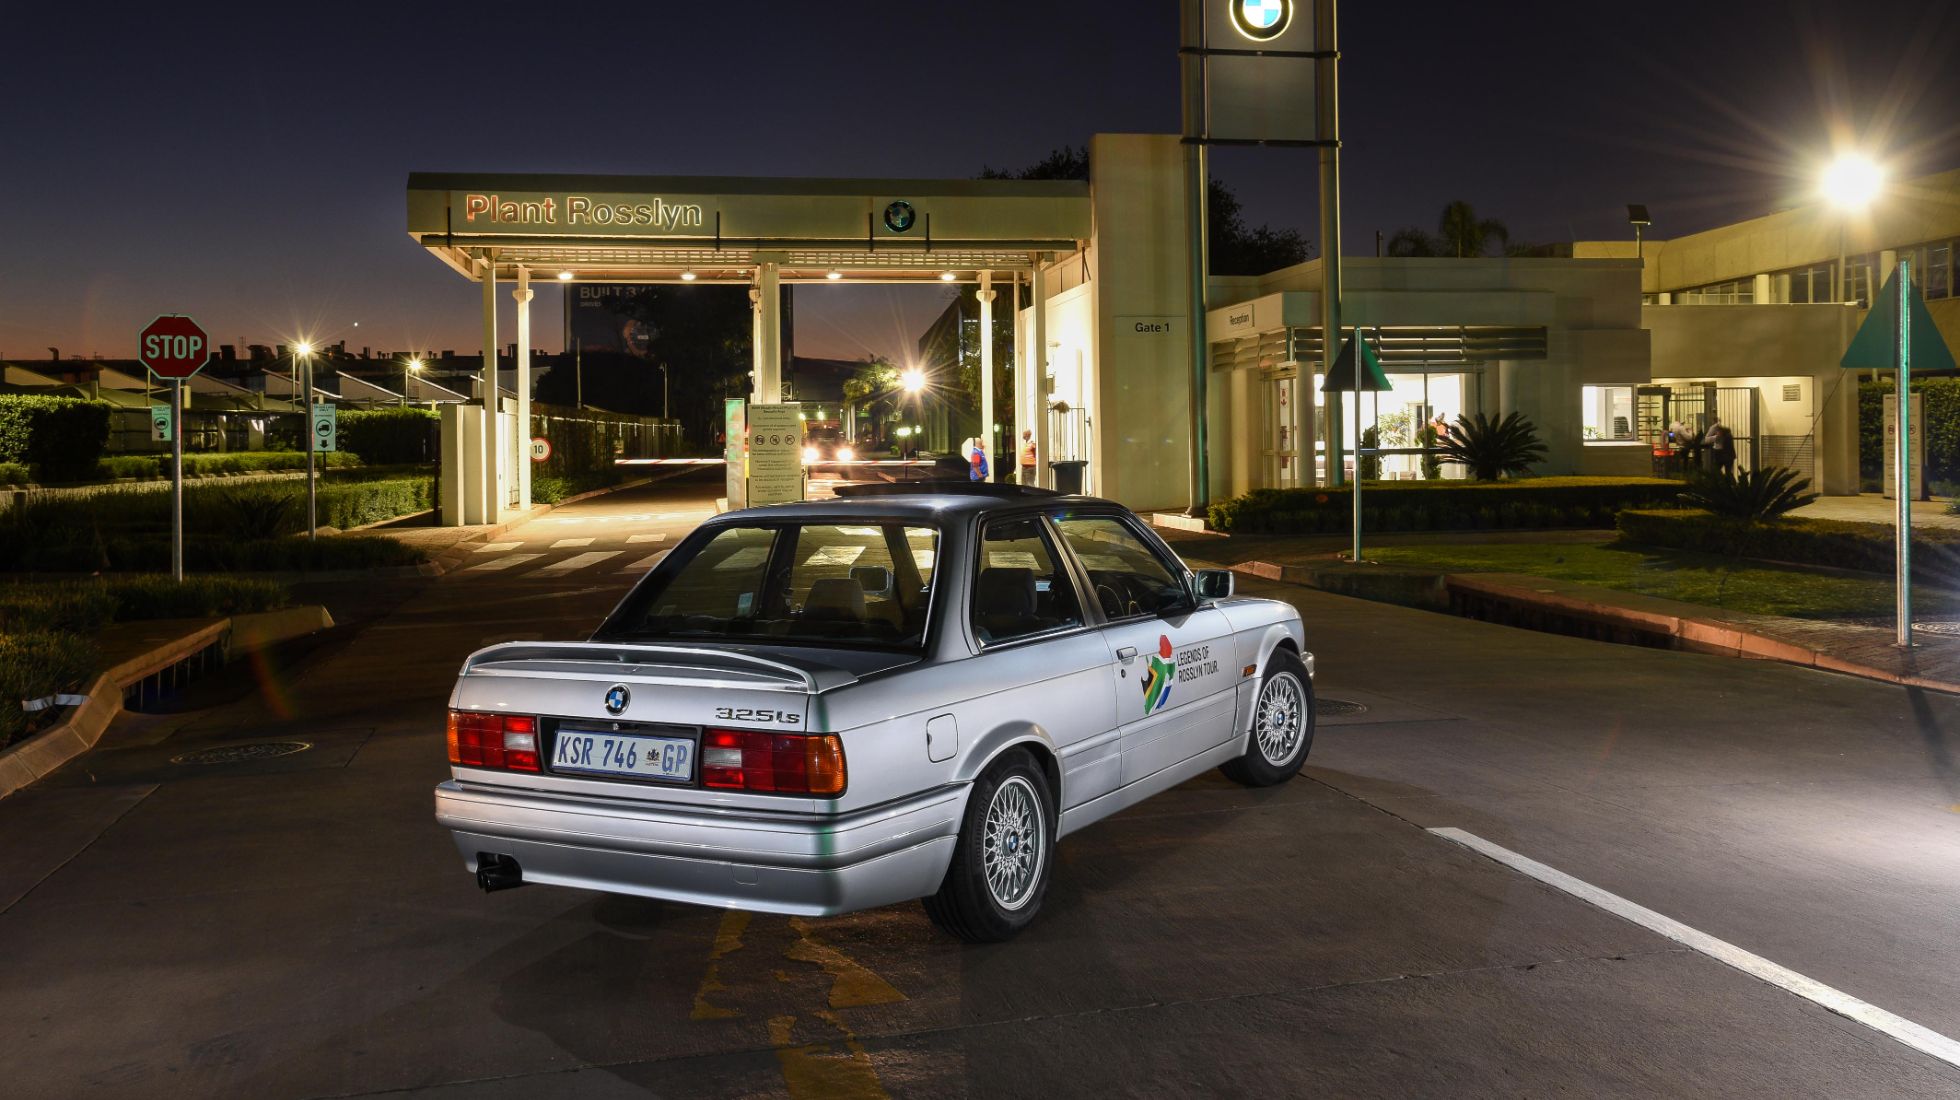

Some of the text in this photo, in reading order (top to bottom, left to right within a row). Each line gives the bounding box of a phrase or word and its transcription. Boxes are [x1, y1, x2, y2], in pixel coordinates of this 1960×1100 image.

[466, 194, 703, 232] Plant Rosslyn
[1135, 322, 1170, 333] Gate 1
[1230, 314, 1250, 326] Reception
[145, 334, 203, 360] STOP
[534, 445, 544, 454] 10
[1176, 645, 1209, 667] LEGENDS OF
[1178, 665, 1204, 683] ROSSLYN
[557, 736, 688, 773] KSR 746 GP
